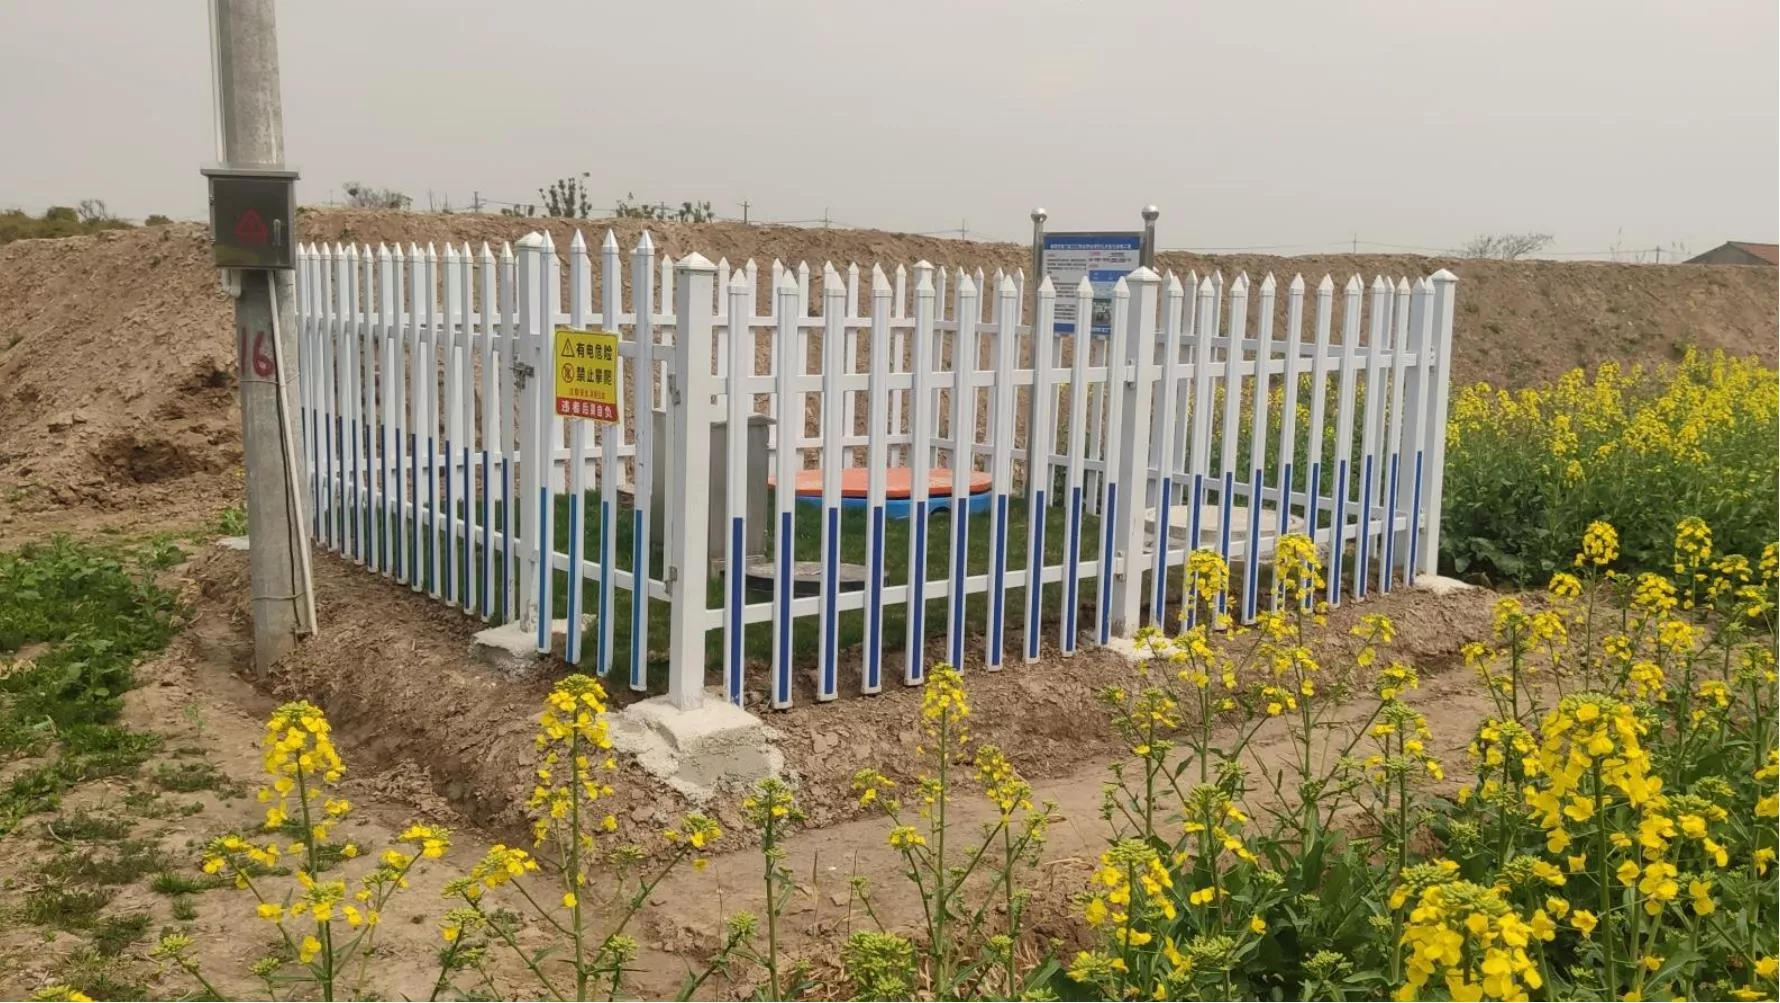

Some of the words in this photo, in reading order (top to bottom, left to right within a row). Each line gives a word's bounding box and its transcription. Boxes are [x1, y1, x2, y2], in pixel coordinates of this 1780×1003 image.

[241, 326, 275, 377] 16
[576, 342, 613, 361] 有电危险
[576, 366, 613, 386] 禁止攀爬
[560, 400, 613, 419] 违者后果自负
